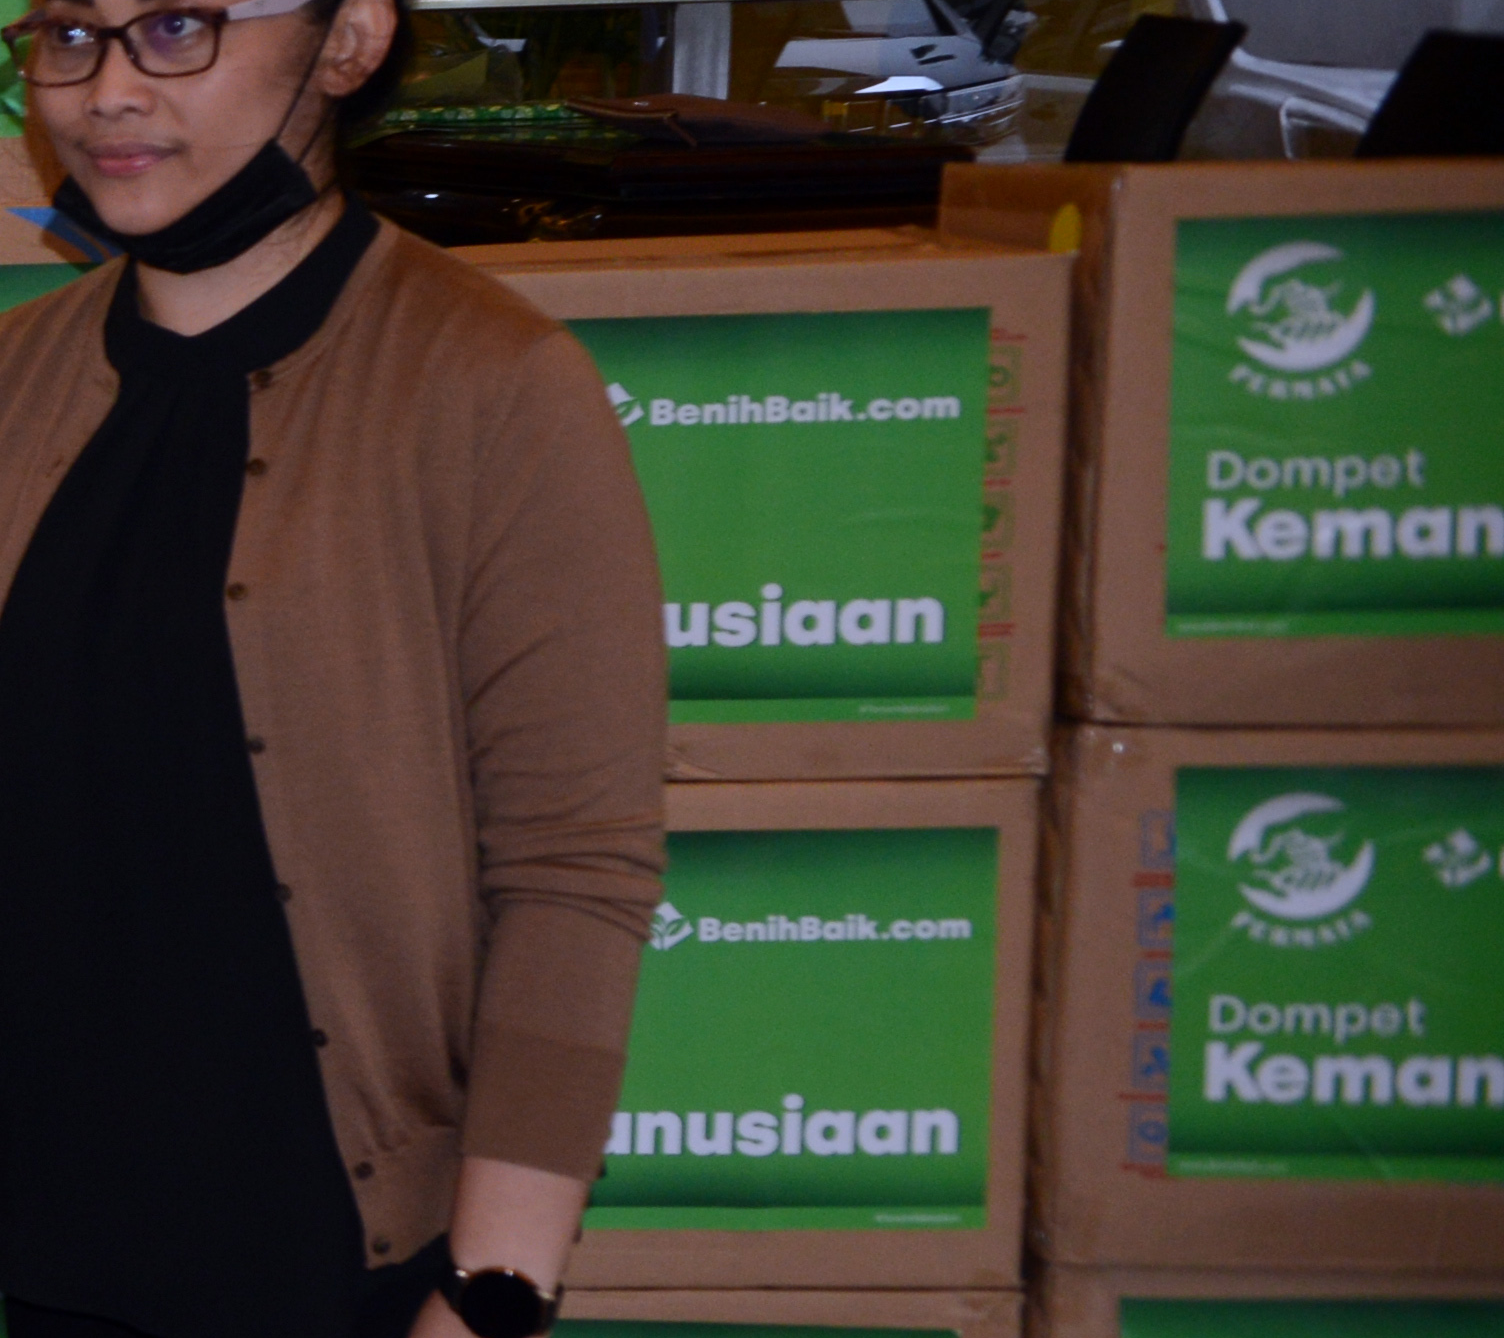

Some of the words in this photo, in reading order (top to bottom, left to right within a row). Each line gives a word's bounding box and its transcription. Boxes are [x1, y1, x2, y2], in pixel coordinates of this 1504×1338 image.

[650, 393, 959, 425] BenihBaik.com
[1206, 449, 1426, 499] Dompet
[698, 914, 970, 942] BenihBaik.com
[1209, 994, 1426, 1045] Dompet
